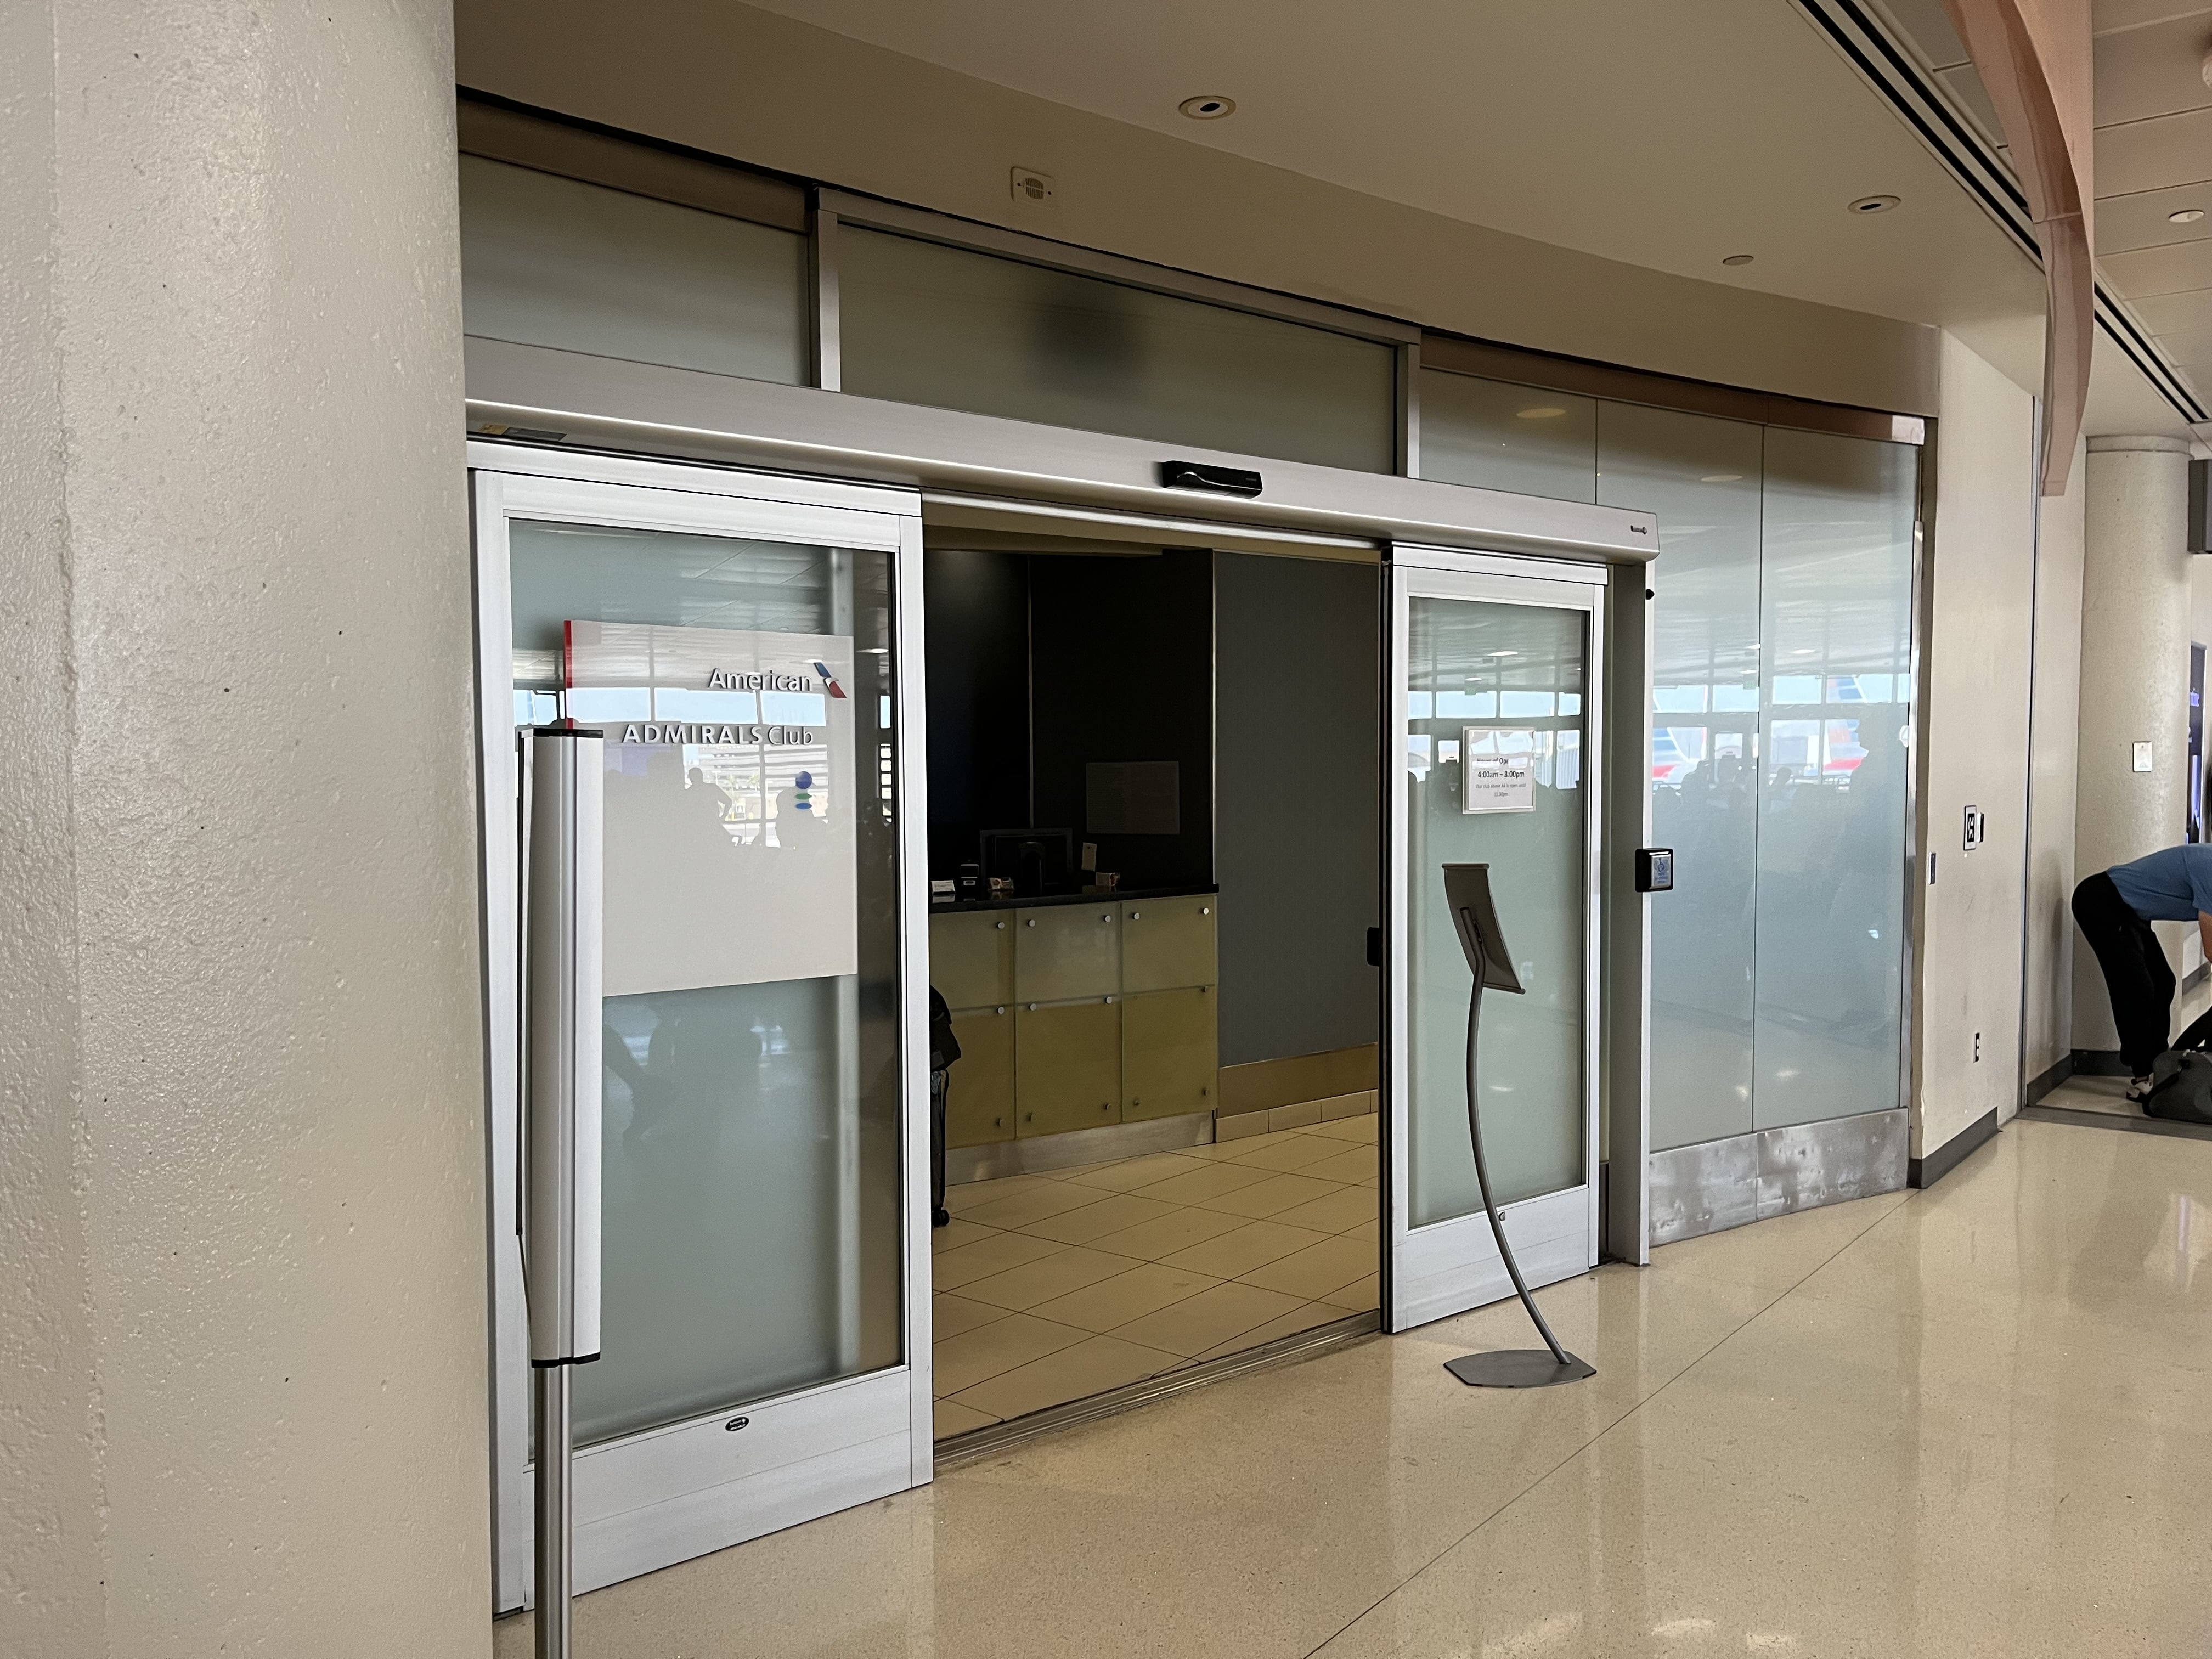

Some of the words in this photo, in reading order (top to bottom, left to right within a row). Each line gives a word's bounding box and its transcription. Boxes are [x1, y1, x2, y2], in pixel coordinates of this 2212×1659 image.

[708, 668, 812, 692] American
[622, 724, 763, 745] ADMIRALS
[767, 726, 814, 746] Club
[1504, 770, 1525, 778] 8:00pm
